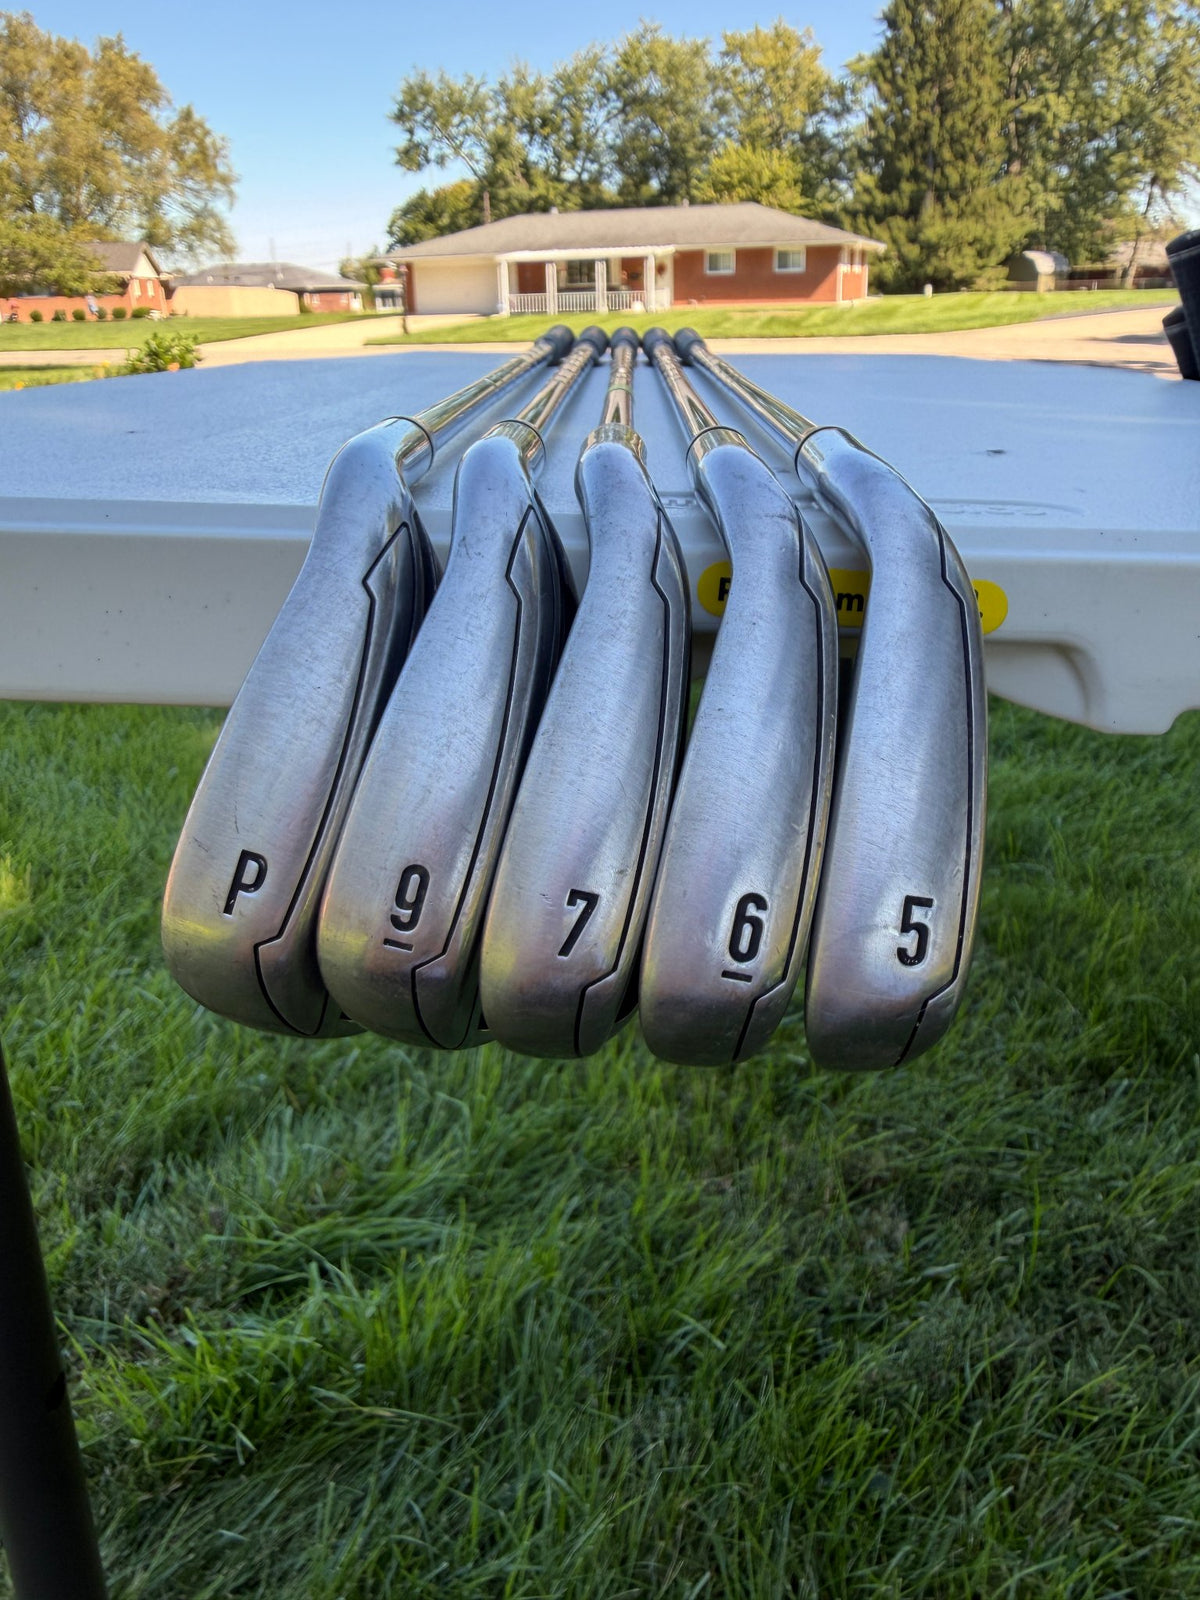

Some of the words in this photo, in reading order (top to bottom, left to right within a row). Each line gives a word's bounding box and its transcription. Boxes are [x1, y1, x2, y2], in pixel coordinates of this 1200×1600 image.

[223, 848, 268, 915] P
[390, 863, 431, 932] 9
[557, 888, 600, 957] 7
[728, 892, 769, 963] 6
[896, 894, 934, 967] 5
